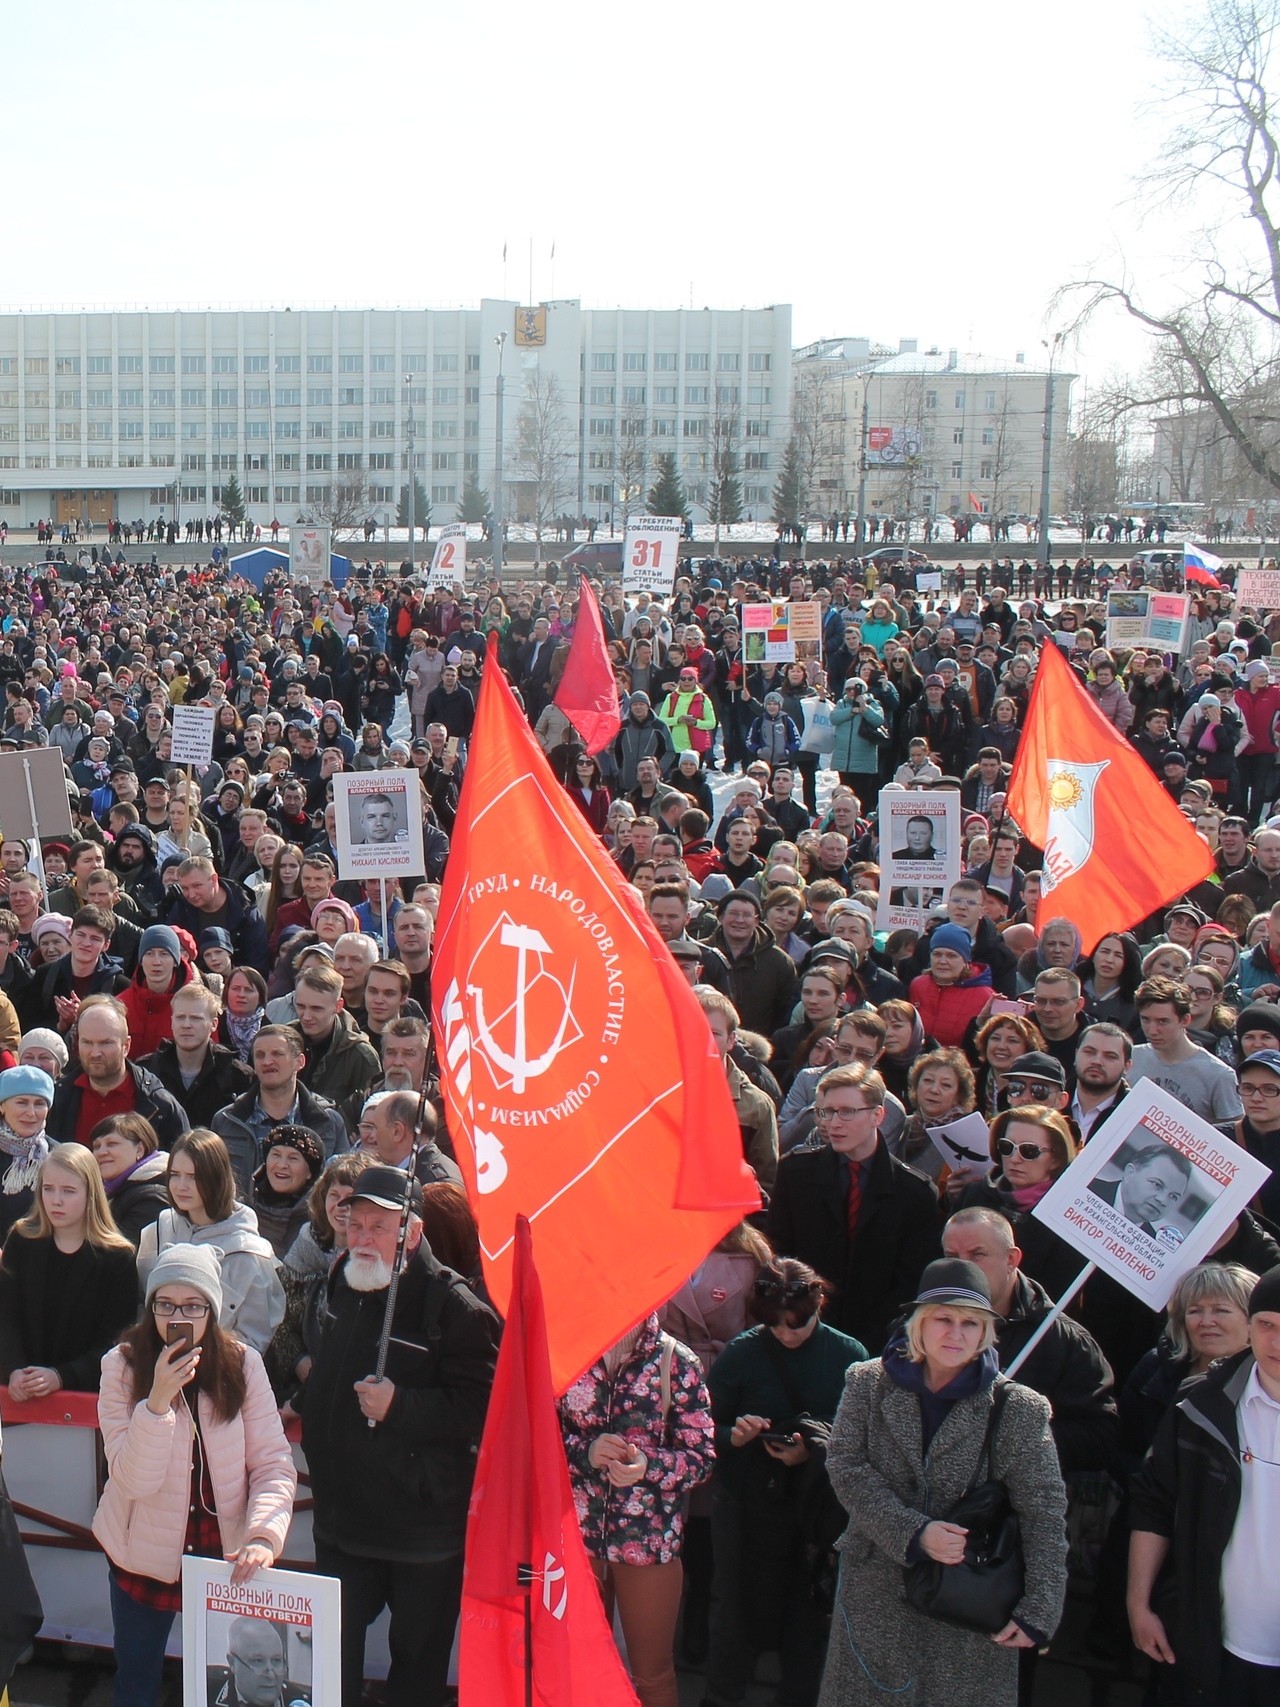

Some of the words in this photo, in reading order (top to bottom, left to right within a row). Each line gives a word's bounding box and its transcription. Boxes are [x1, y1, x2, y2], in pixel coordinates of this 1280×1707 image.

[632, 540, 662, 568] 31
[624, 576, 673, 585] КОНСТИТУЦИИ
[1251, 581, 1256, 589] В
[347, 778, 385, 787] ПОЗОРНЫЙ
[387, 778, 406, 786] ПОЛК
[891, 801, 926, 809] ПОЗОРНЫЙ
[352, 859, 377, 867] МИХАИЛ
[378, 857, 411, 865] КИСЛЯКОВ
[467, 873, 509, 904] ТРУД
[889, 917, 907, 925] ИВАН
[530, 874, 625, 1045] НАРОДОВЛАСТИЕ
[490, 1070, 601, 1127] СОЦИАЛИЗМ
[1144, 1118, 1181, 1150] ВЛАСТЬ
[1188, 1151, 1227, 1184] ОТВЕТУ!
[1146, 1105, 1209, 1153] ПОЗОРНЫЙ
[1207, 1147, 1241, 1179] ПОЛК
[1074, 1199, 1082, 1207] ОТ
[1082, 1206, 1137, 1247] АРХАНГЕЛЬСКОЙ
[1134, 1244, 1165, 1270] ОБЛАСТИ
[1086, 1195, 1102, 1210] ЧЛЕН
[1102, 1207, 1127, 1230] СОВЕТА
[1127, 1226, 1166, 1258] ФЕДЕРАЦИИ
[1063, 1206, 1104, 1240] ВИКТОР
[1102, 1236, 1156, 1282] ПАВЛЕНКО
[206, 1582, 273, 1606] ПОЗОРНЫЙ
[278, 1594, 313, 1613] ПОЛК
[211, 1600, 253, 1615] ВЛАСТЬ
[254, 1609, 262, 1617] К
[264, 1609, 307, 1625] ОТВЕТУ!
